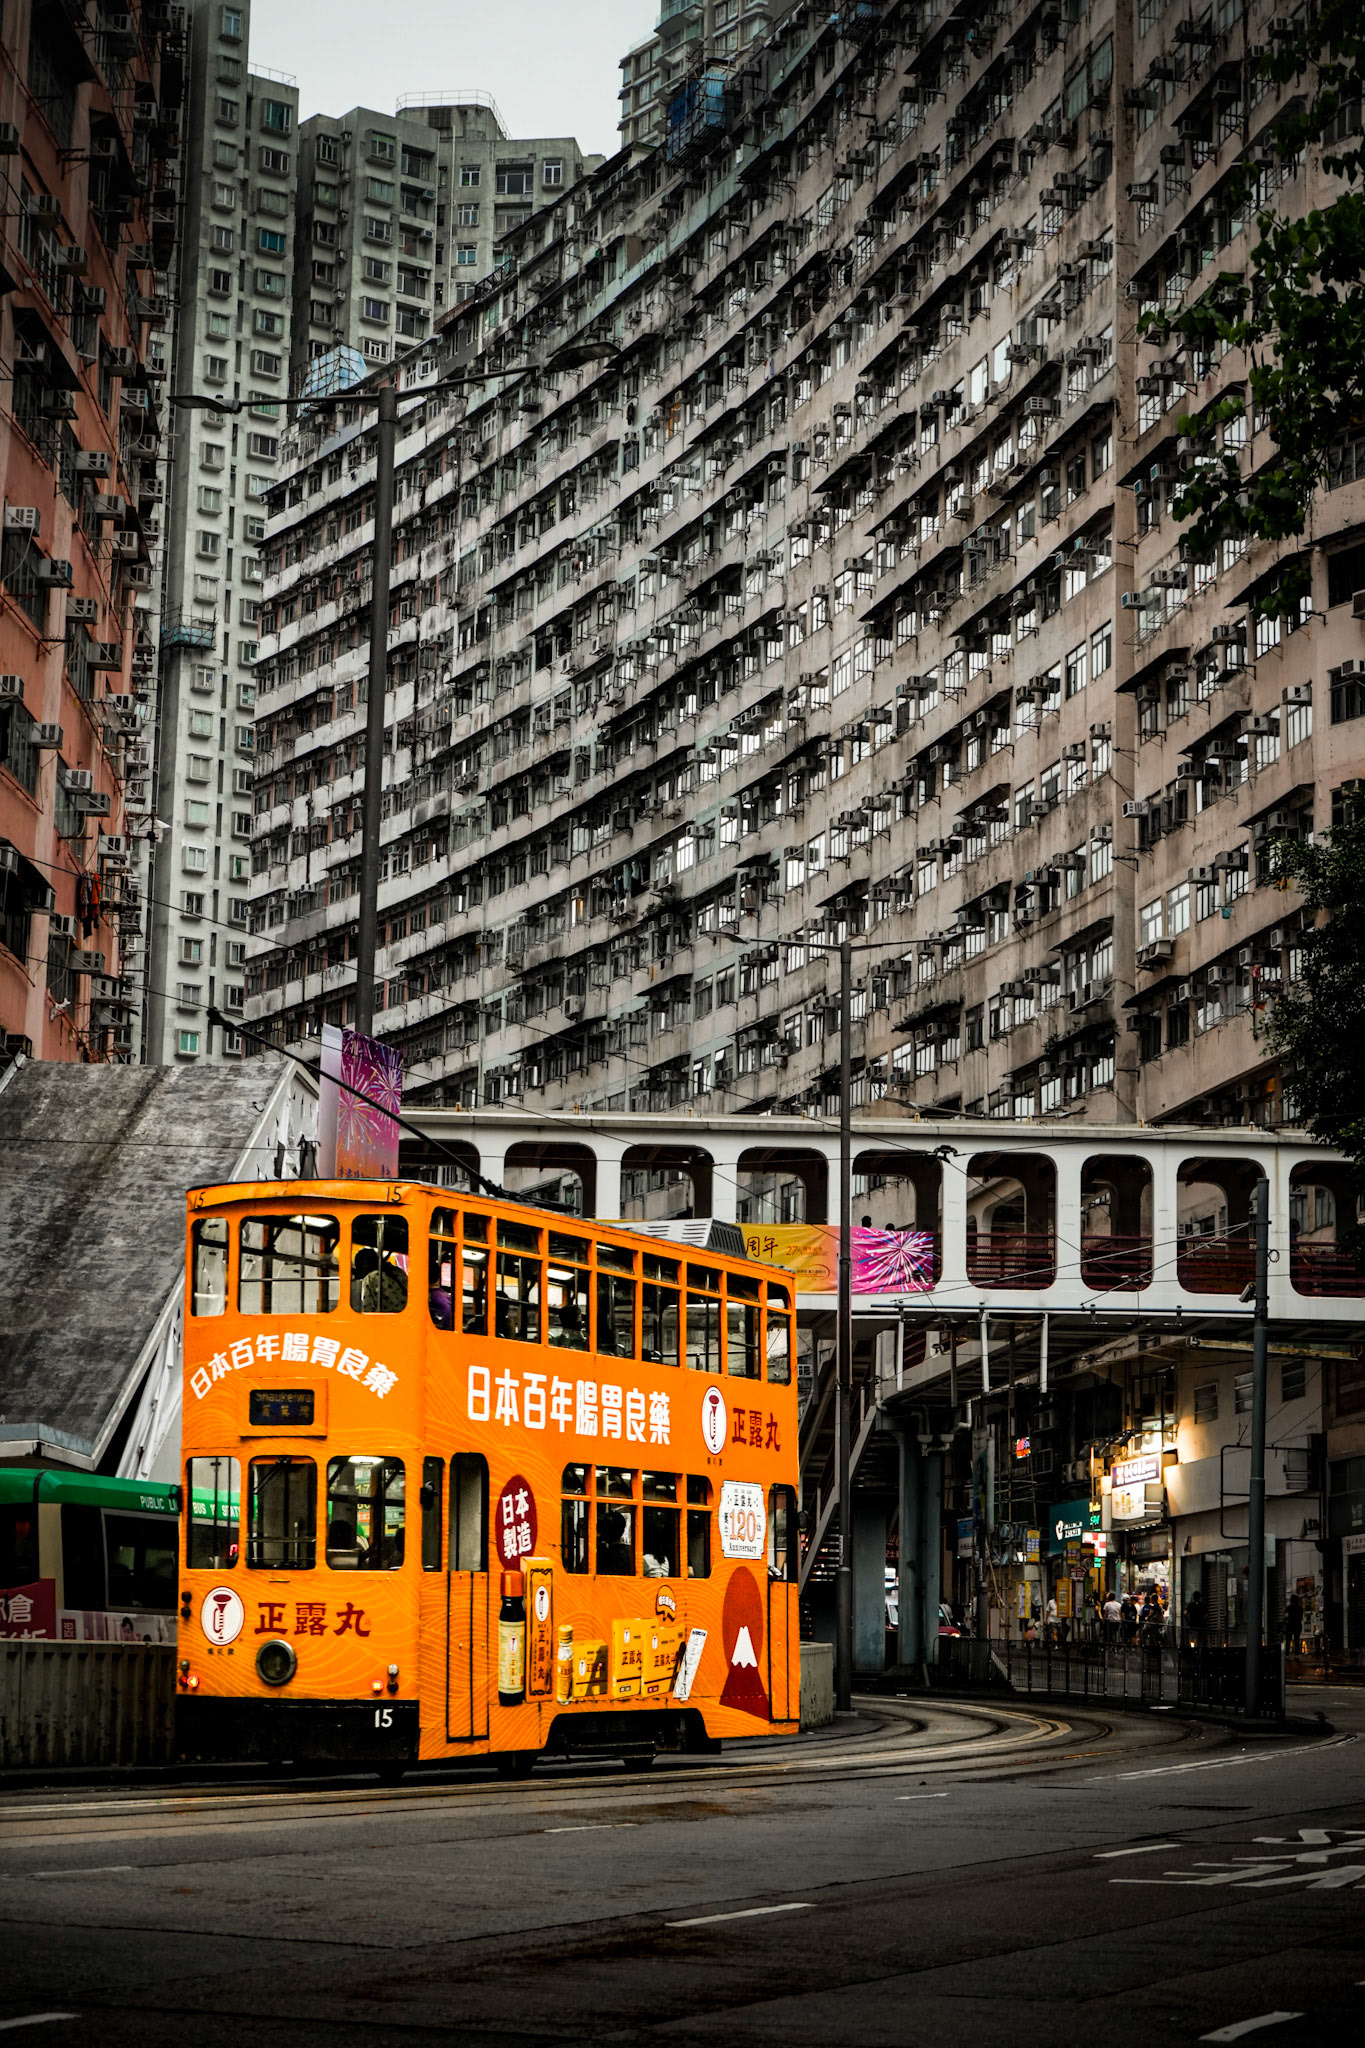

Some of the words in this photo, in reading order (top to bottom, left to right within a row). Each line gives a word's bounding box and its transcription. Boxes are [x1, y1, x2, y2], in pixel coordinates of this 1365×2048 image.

[387, 1186, 402, 1203] 15
[746, 1235, 779, 1259] 周年
[190, 1332, 399, 1400] 日本百年腸胃良藥
[468, 1364, 671, 1446] 日本百年腸胃良藥
[732, 1407, 780, 1452] 正露丸
[140, 1495, 165, 1510] PUBLIC
[729, 1508, 757, 1542] 120
[254, 1601, 371, 1637] 正露丸
[375, 1708, 393, 1728] 15
